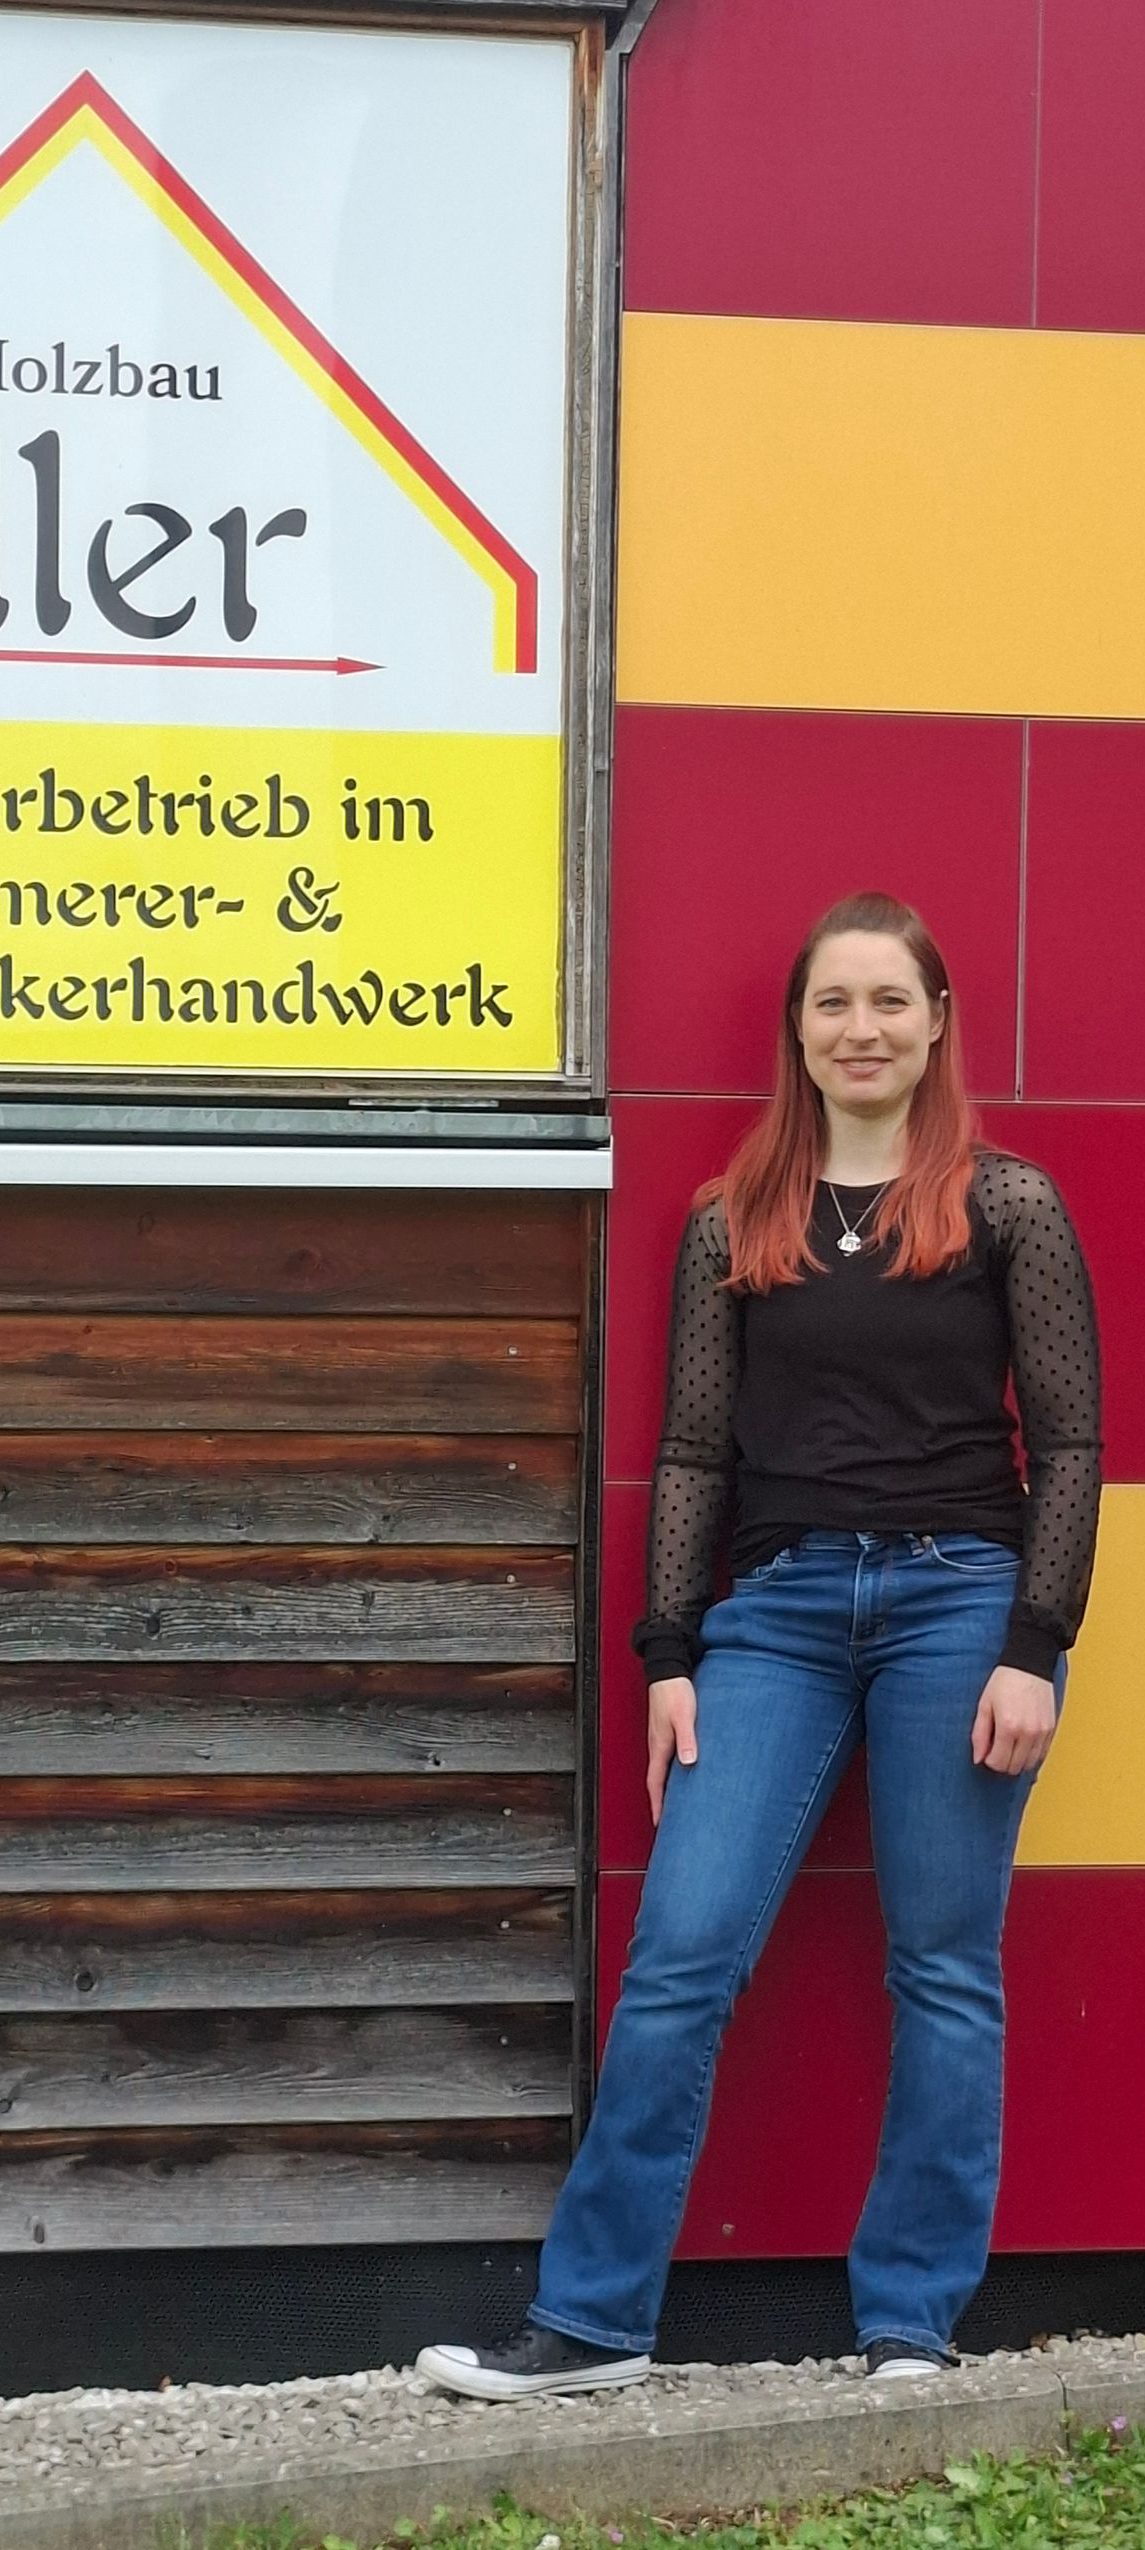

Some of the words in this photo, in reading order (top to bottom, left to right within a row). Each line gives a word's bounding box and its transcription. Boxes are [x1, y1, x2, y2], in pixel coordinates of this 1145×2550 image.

[0, 339, 223, 401] olzbau
[0, 430, 307, 643] ler
[1, 767, 310, 838] rbetrieb
[340, 778, 434, 842] im
[277, 866, 343, 933] &
[0, 954, 513, 1028] kerhandwerk
